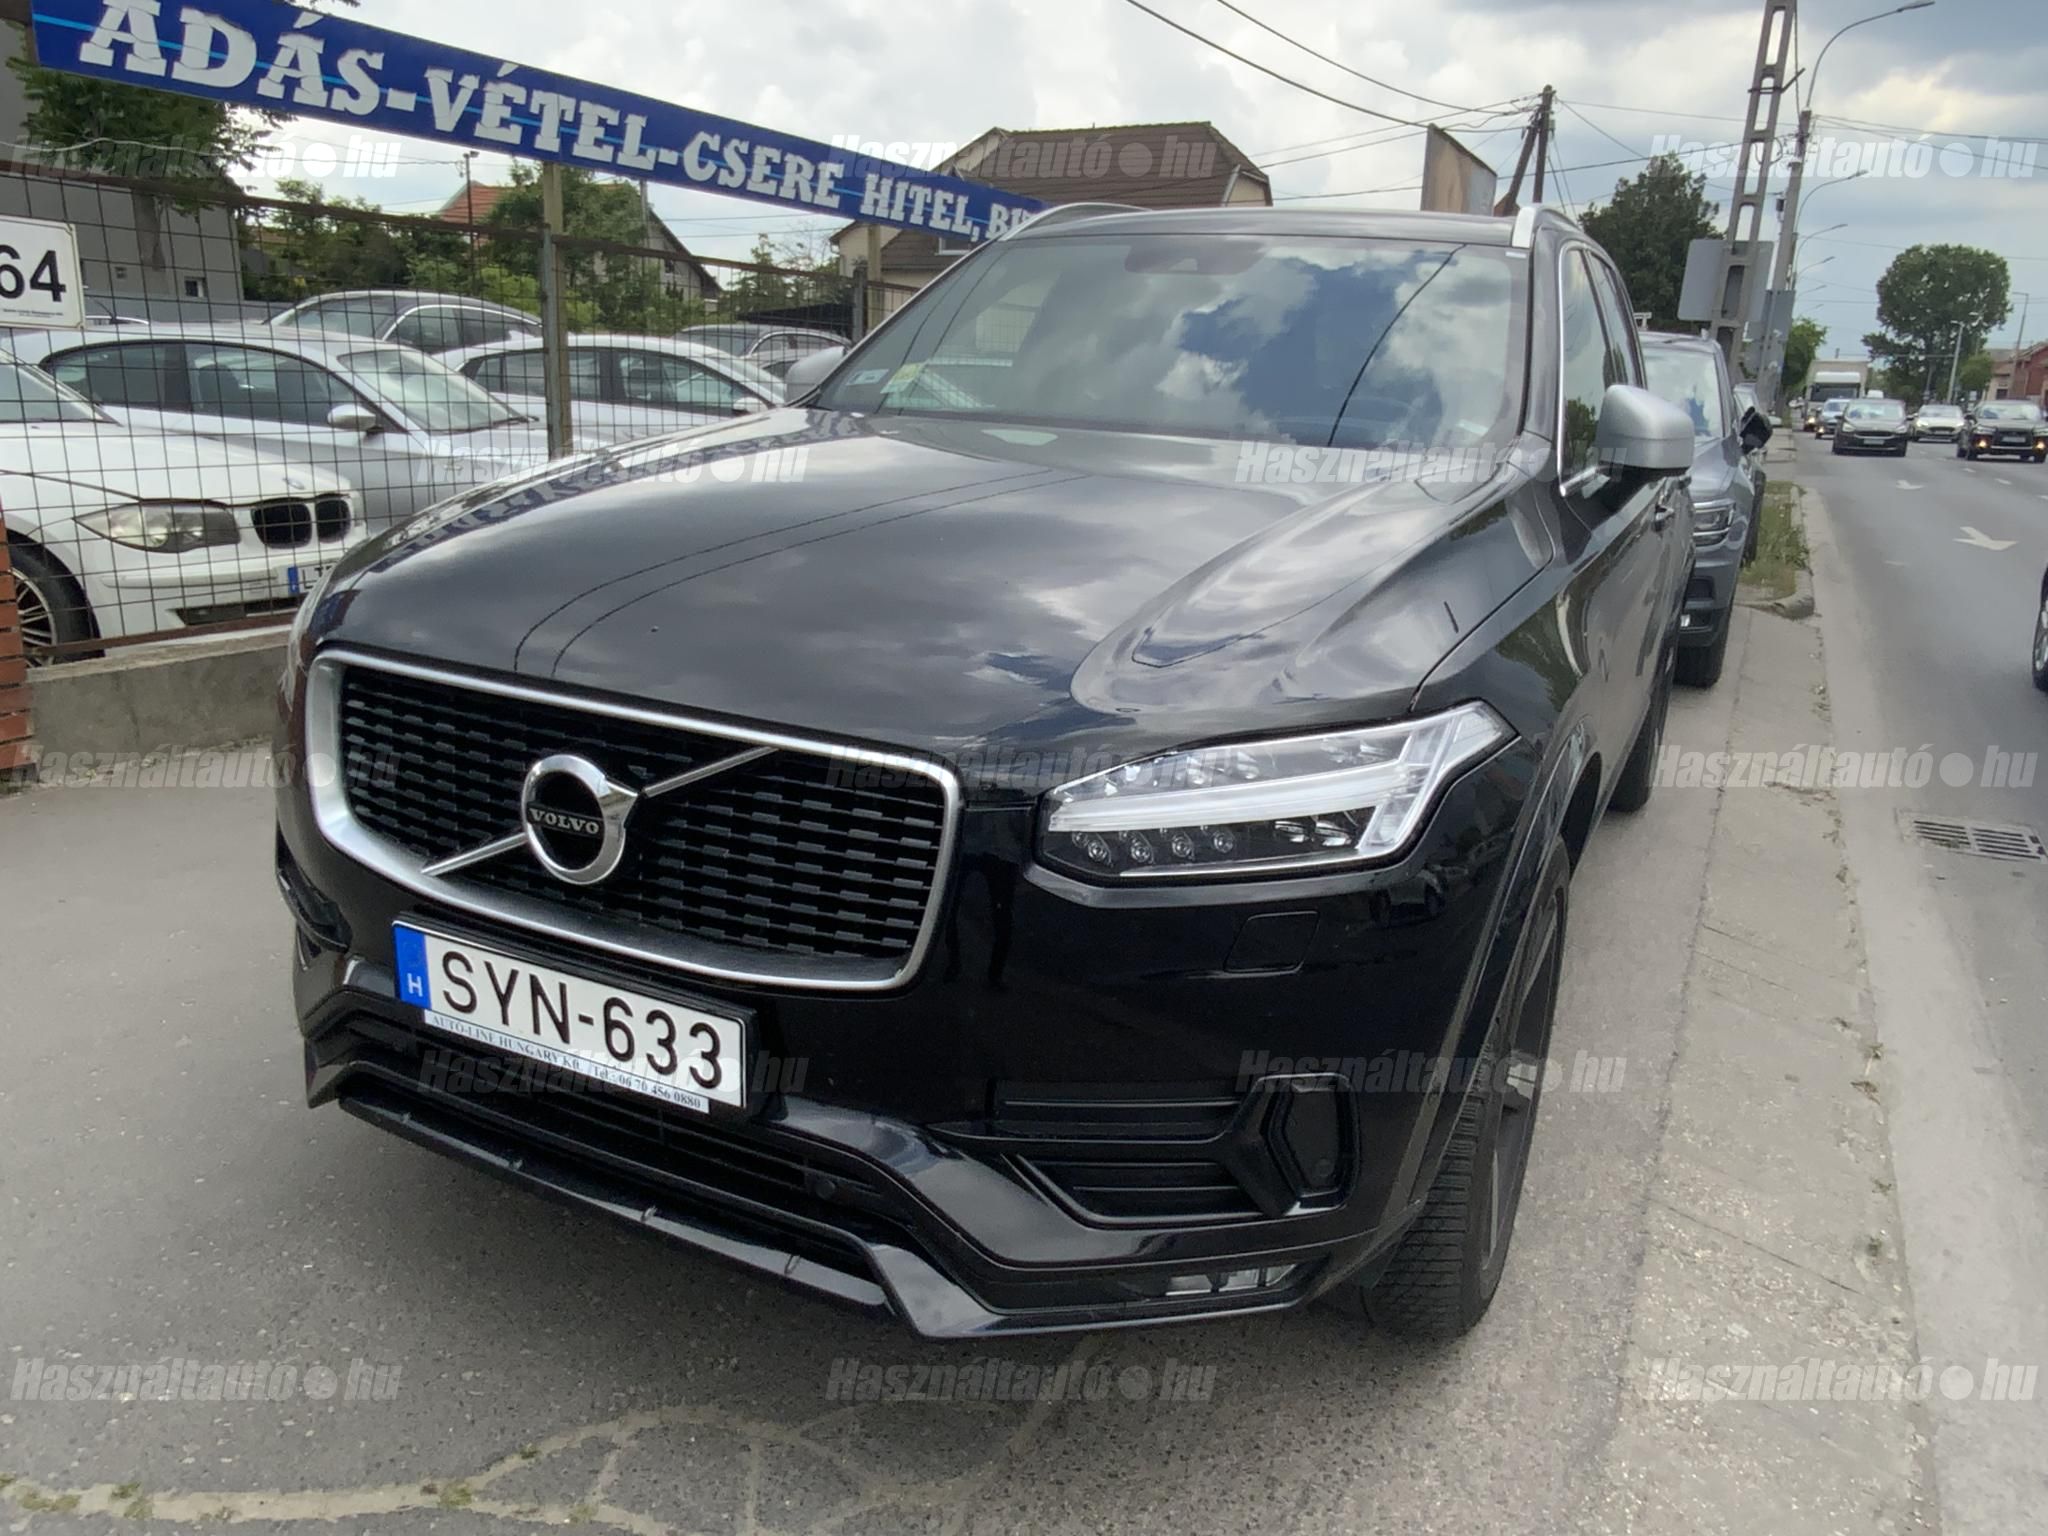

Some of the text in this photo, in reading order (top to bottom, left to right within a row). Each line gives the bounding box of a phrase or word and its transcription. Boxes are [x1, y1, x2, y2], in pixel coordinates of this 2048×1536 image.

[860, 173, 980, 242] HITEL,
[529, 808, 599, 834] VOLVO
[407, 973, 423, 998] H
[442, 951, 722, 1090] SYN-633
[499, 1034, 560, 1062] HUNGARY
